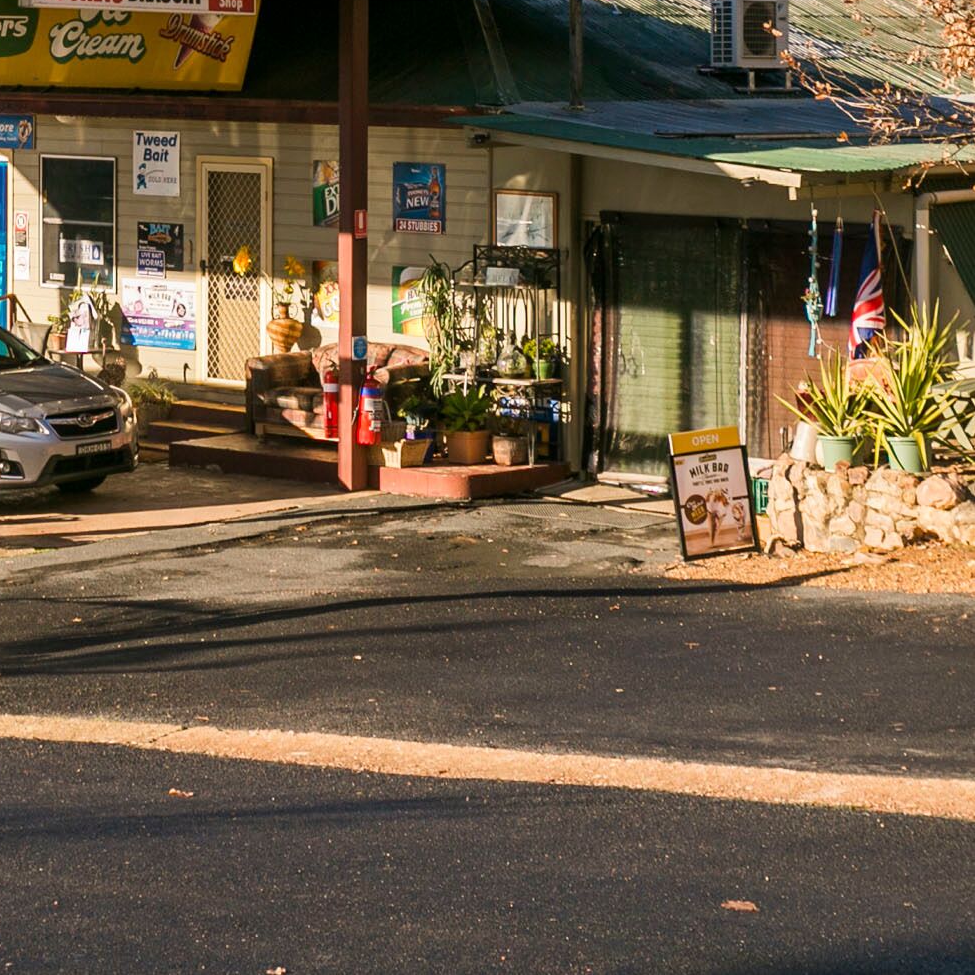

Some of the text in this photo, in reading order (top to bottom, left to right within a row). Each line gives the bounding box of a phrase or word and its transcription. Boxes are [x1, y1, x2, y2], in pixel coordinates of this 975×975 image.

[50, 21, 145, 60] Cream
[160, 12, 234, 61] Drumstick
[136, 133, 178, 147] Tweed
[144, 148, 169, 162] Bait
[406, 195, 430, 209] NEW
[399, 220, 439, 233] 24 STUBBIES
[139, 258, 163, 267] WORMS
[692, 434, 720, 446] OPEN
[689, 462, 730, 478] MILK BAR
